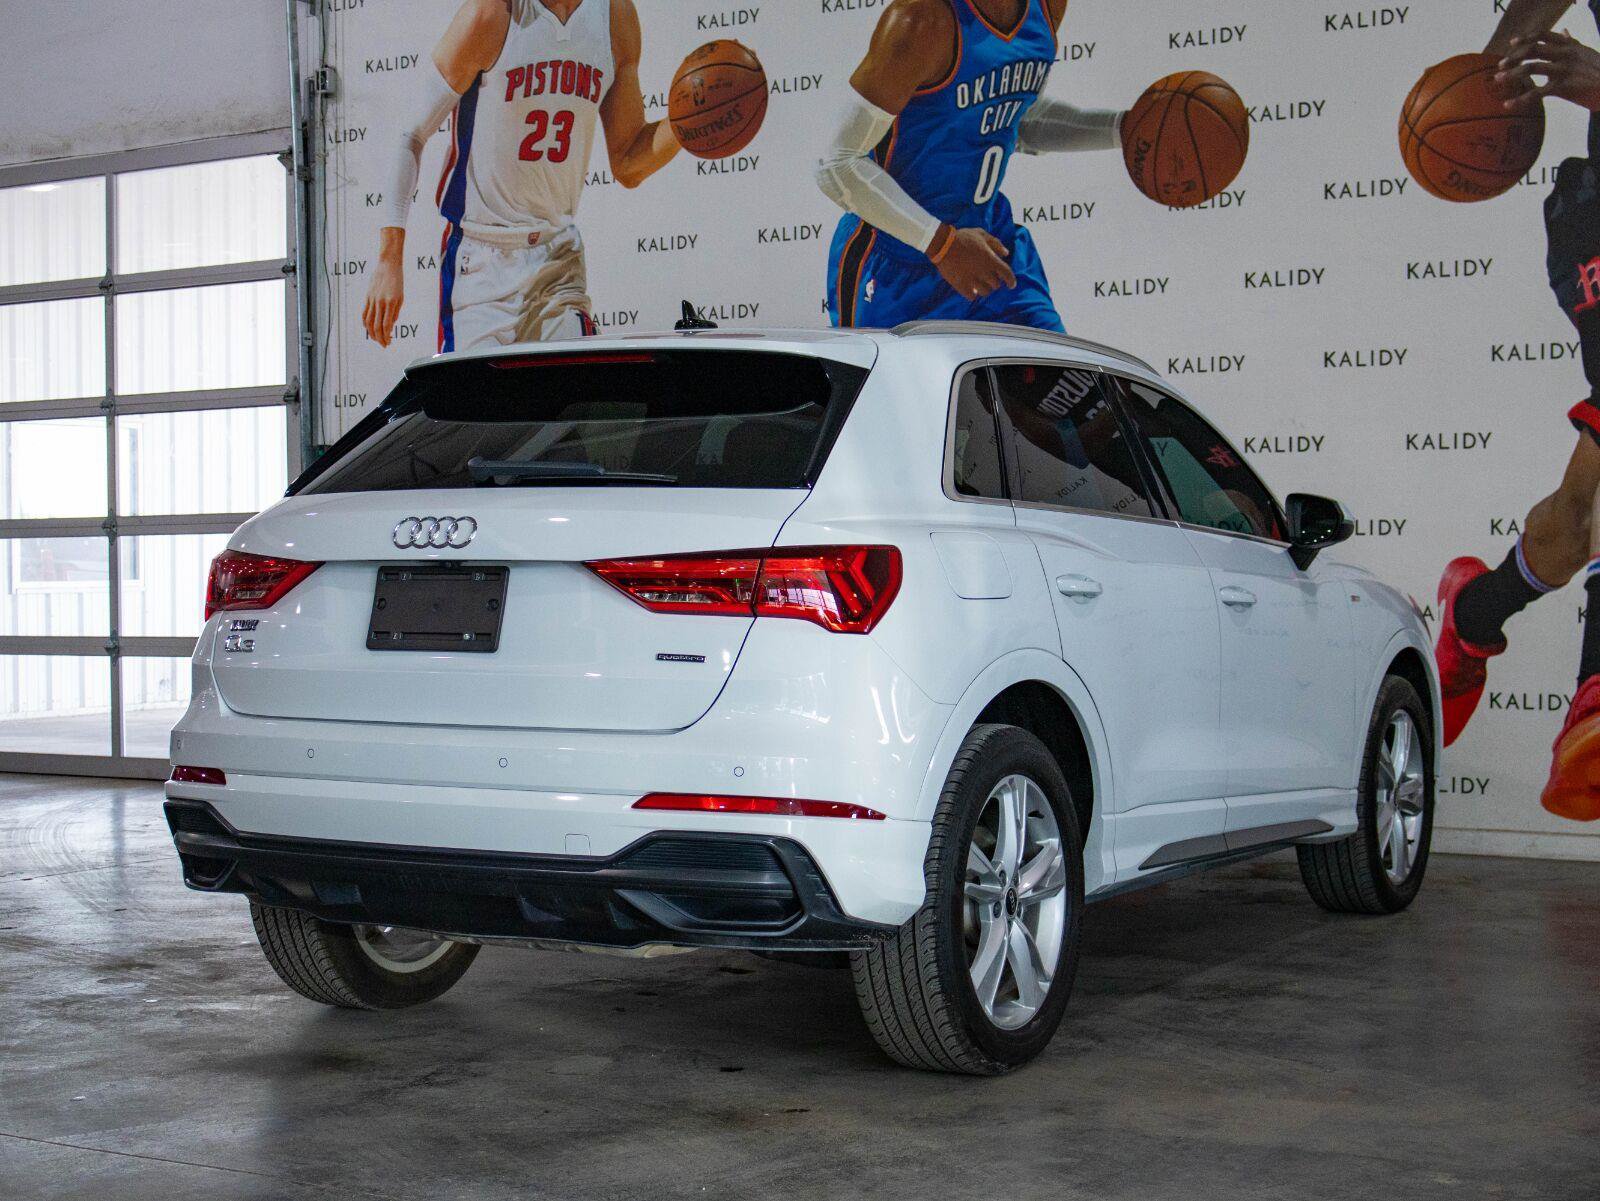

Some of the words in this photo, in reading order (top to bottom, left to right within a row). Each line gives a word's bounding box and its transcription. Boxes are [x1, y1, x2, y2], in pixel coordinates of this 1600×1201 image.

[698, 8, 759, 30] KALIDY
[1325, 7, 1409, 31] KALIDY
[1169, 25, 1246, 49] KALIDY
[1054, 42, 1096, 62] IDY
[366, 54, 418, 73] KALIDY
[505, 60, 603, 104] PISTONS
[771, 75, 823, 94] ALIDY
[956, 60, 1048, 109] OKLAHOM
[980, 99, 1022, 135] CITY
[1247, 100, 1326, 122] KALIDY
[519, 109, 575, 163] 23
[697, 155, 760, 175] KALIDY
[1324, 178, 1409, 200] KALIDY
[1023, 202, 1095, 223] KALIDY
[638, 234, 697, 252] KALIDY
[759, 224, 822, 243] KALIDY
[334, 260, 367, 275] LIDY
[1407, 258, 1493, 280] KALIDY
[1095, 277, 1169, 298] KALIDY
[1245, 268, 1325, 288] KALIDY
[592, 310, 639, 326] ALIDY
[697, 303, 760, 320] KALIDY
[1324, 349, 1408, 368] KALIDY
[1491, 342, 1581, 363] KALIDY
[1168, 355, 1245, 374] KALIDY
[334, 394, 367, 408] LIDY
[1245, 436, 1325, 454] KALIDY
[1406, 432, 1492, 451] KALIDY
[1354, 519, 1406, 536] LIDY
[1439, 777, 1490, 795] IDY
